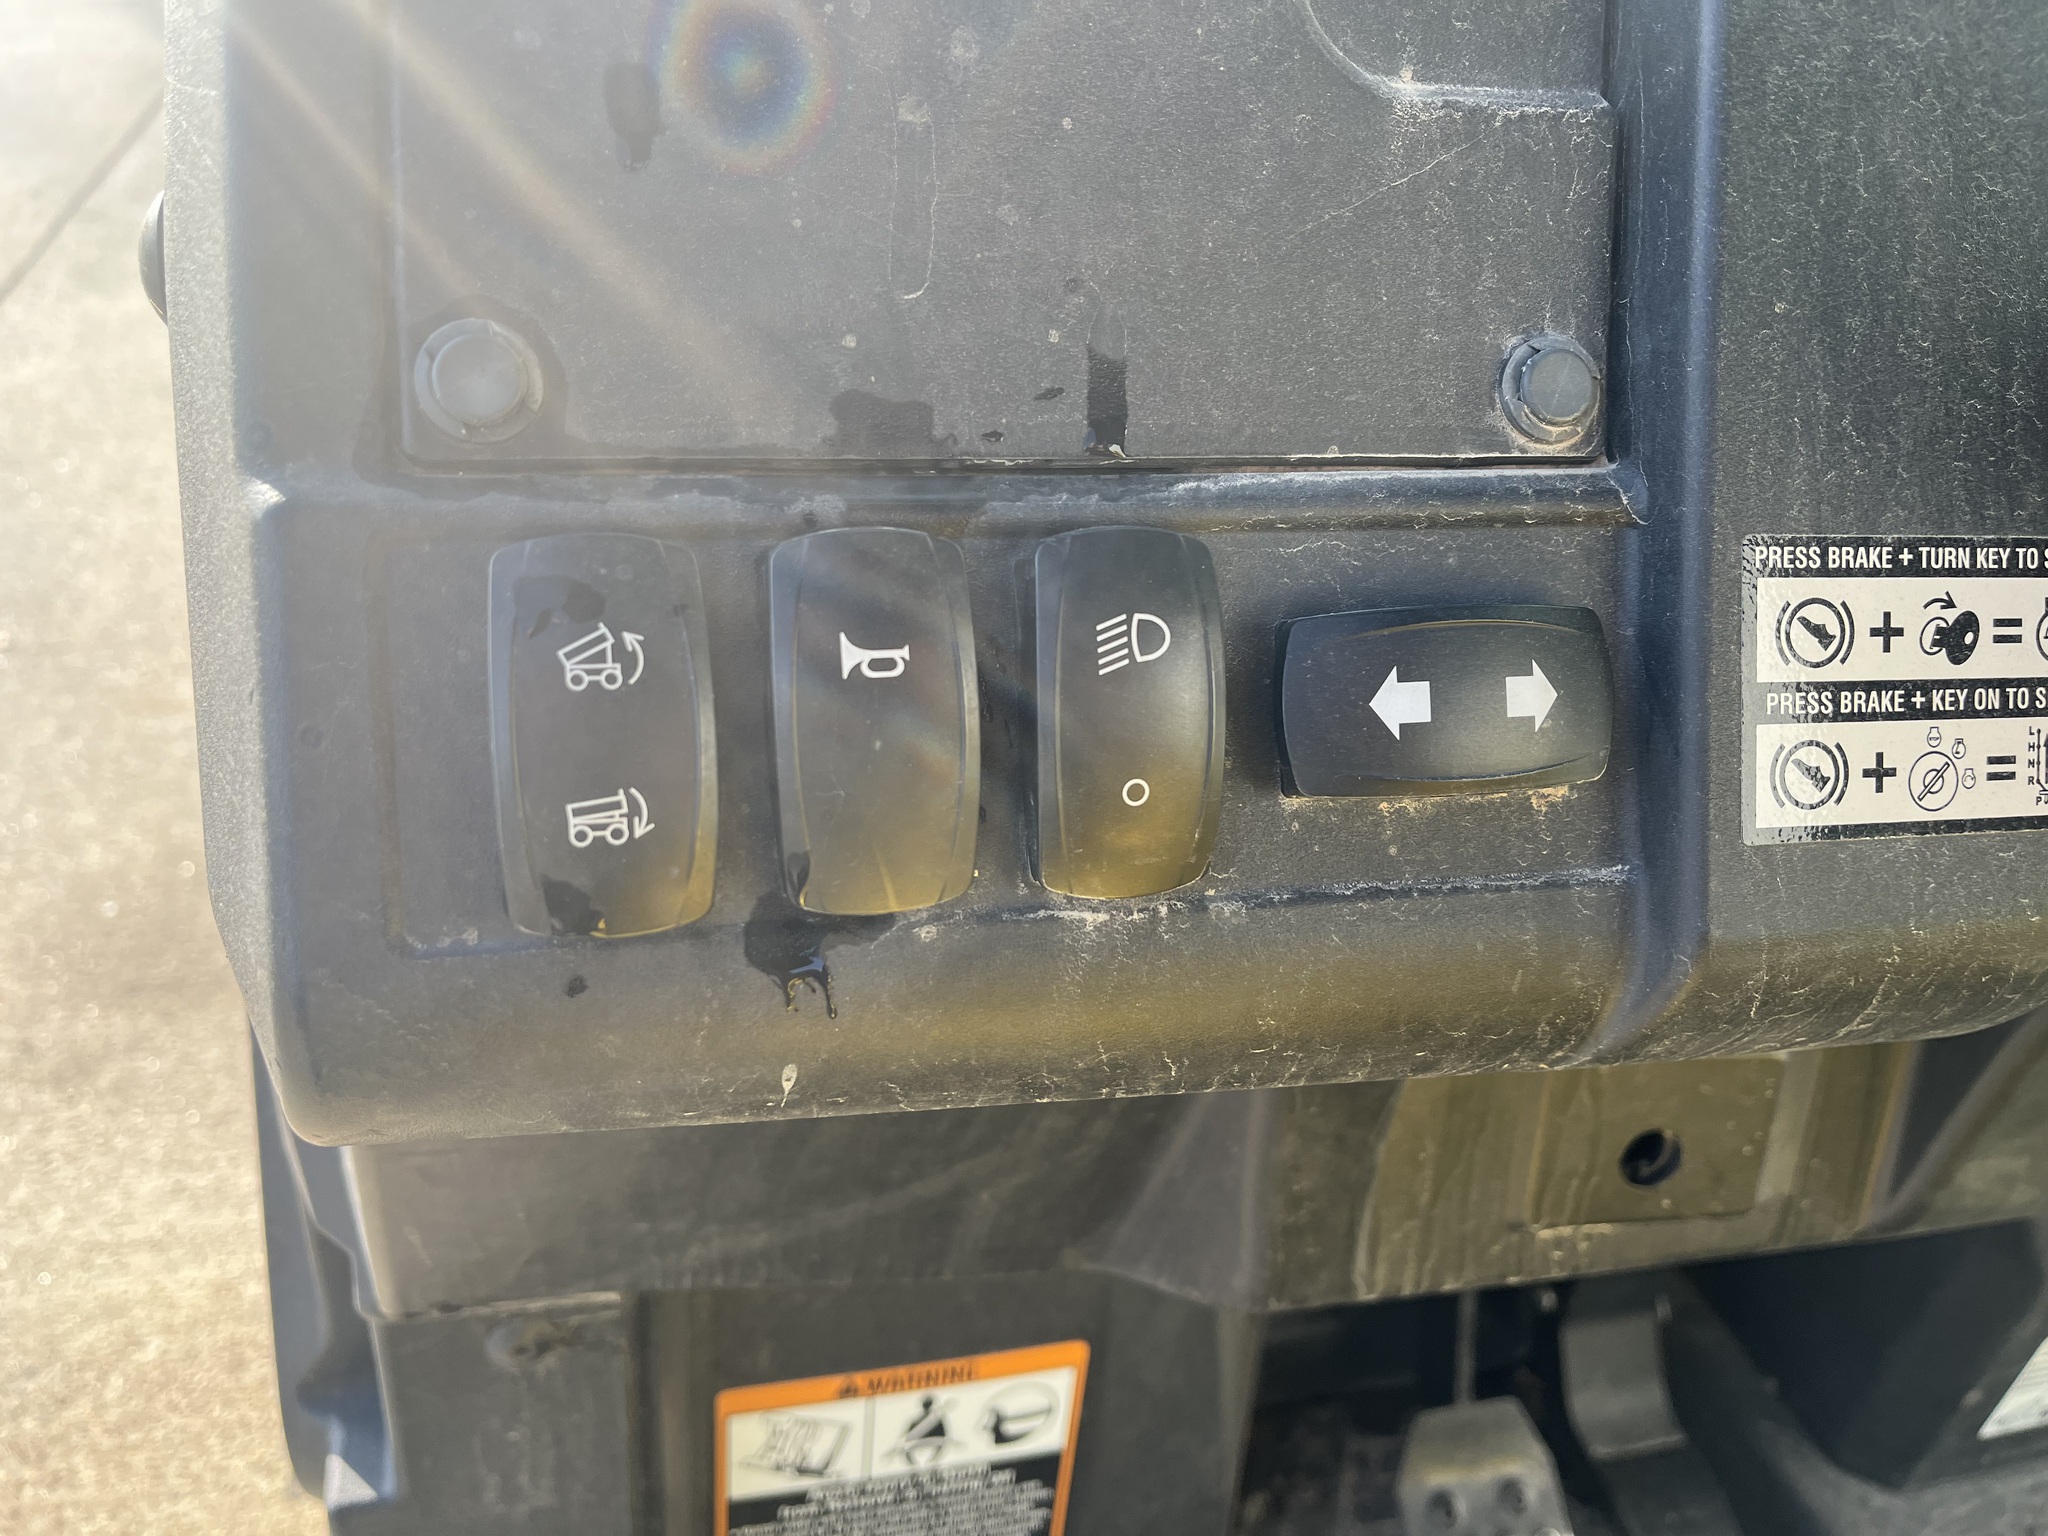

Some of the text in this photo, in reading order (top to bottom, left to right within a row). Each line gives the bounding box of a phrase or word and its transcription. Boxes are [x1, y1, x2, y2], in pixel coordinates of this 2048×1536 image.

[1755, 547, 1821, 569] PRESS
[1828, 547, 1892, 569] BRAKE
[1920, 547, 1970, 569] TURN
[1976, 547, 2010, 569] KEY
[2016, 547, 2039, 569] TO
[1766, 692, 1833, 715] PRESS
[1840, 690, 1905, 713] BRAKE
[1932, 689, 1968, 711] KEY
[1974, 688, 2000, 710] ON
[2006, 687, 2029, 709] TO
[2028, 726, 2035, 736] L
[2028, 742, 2035, 752] H
[2028, 758, 2035, 768] N
[2028, 775, 2035, 785] R
[2036, 796, 2042, 806] P
